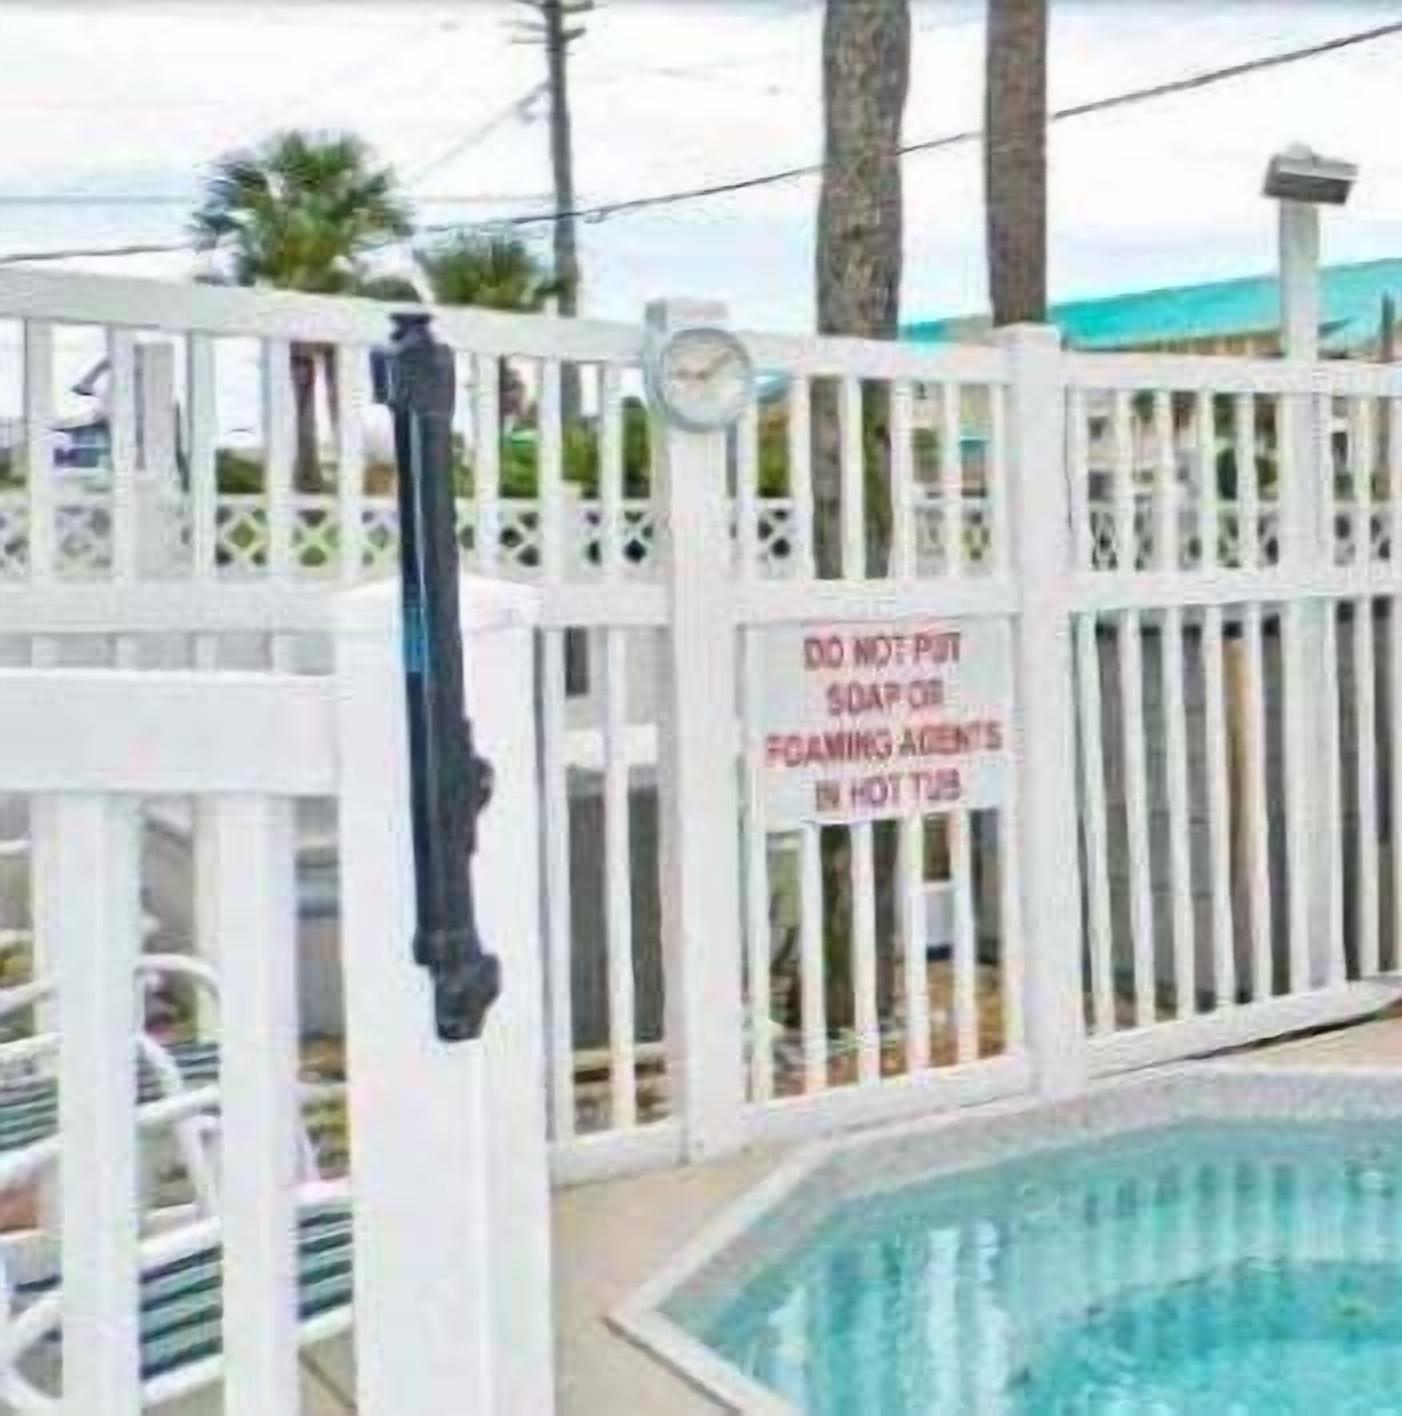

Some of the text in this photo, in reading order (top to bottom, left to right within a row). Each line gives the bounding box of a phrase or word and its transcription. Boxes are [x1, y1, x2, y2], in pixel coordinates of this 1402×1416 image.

[803, 631, 961, 670] DO NOT PUT
[826, 679, 944, 717] SOAP OR
[764, 720, 1003, 767] FOAMING AGENTS
[815, 768, 961, 811] IN HOT TUB
